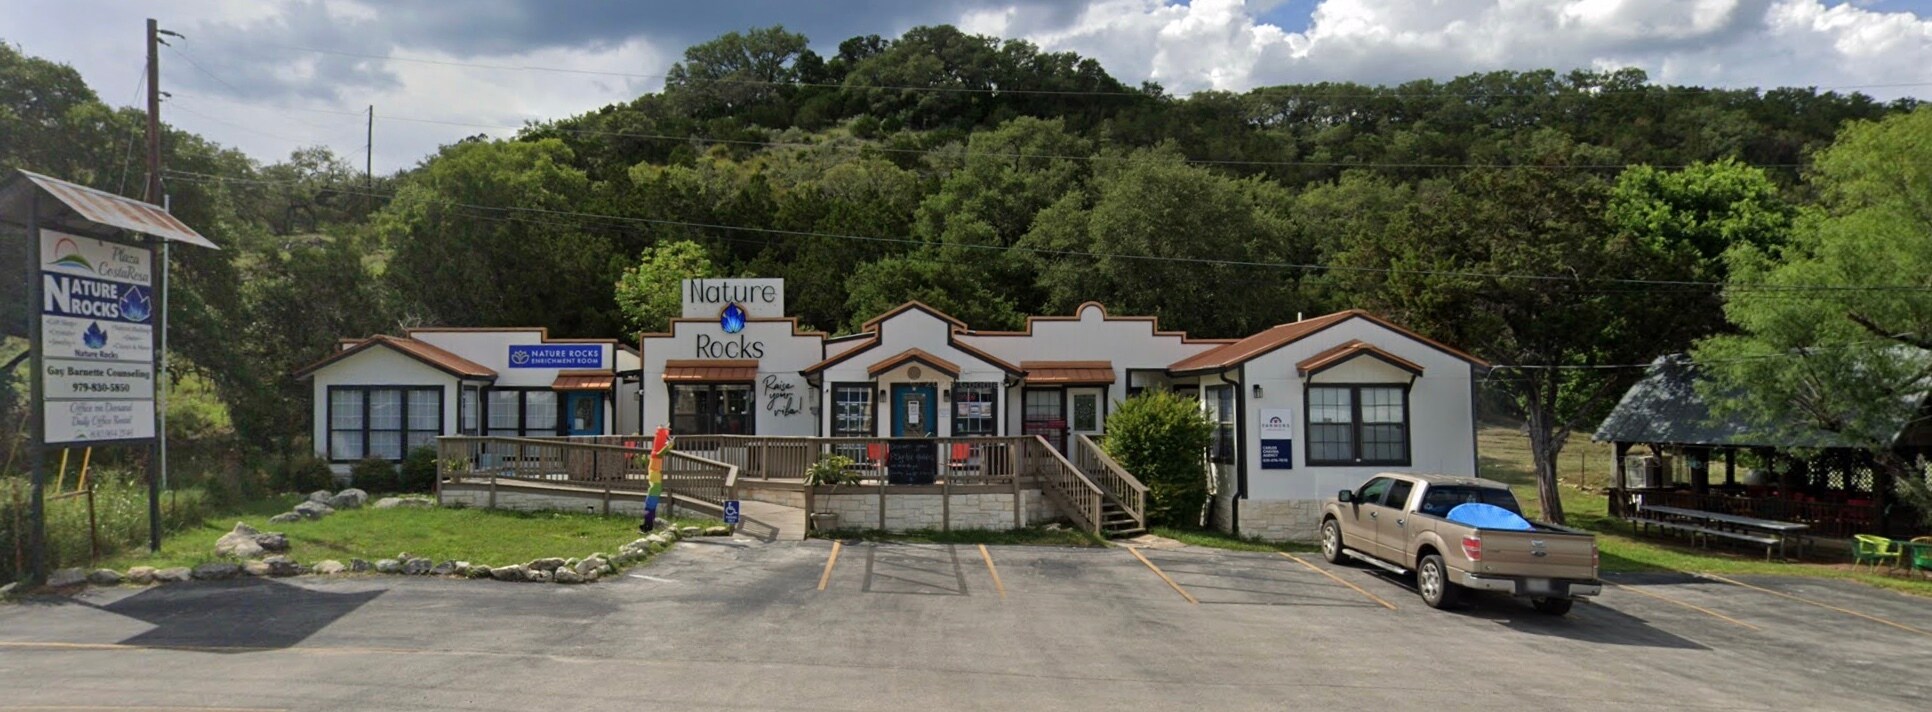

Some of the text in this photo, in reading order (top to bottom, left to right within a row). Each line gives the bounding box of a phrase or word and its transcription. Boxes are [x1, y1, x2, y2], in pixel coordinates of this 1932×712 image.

[43, 274, 118, 312] NATURE
[690, 279, 777, 303] Nature
[71, 298, 119, 318] ROCKS
[74, 350, 119, 359] Nature Rocks
[531, 349, 599, 358] NATURE ROCKS
[696, 334, 765, 359] Rocks
[47, 365, 150, 380] Gay Barnette Counseling
[762, 374, 795, 396] Raise
[766, 392, 793, 411] your
